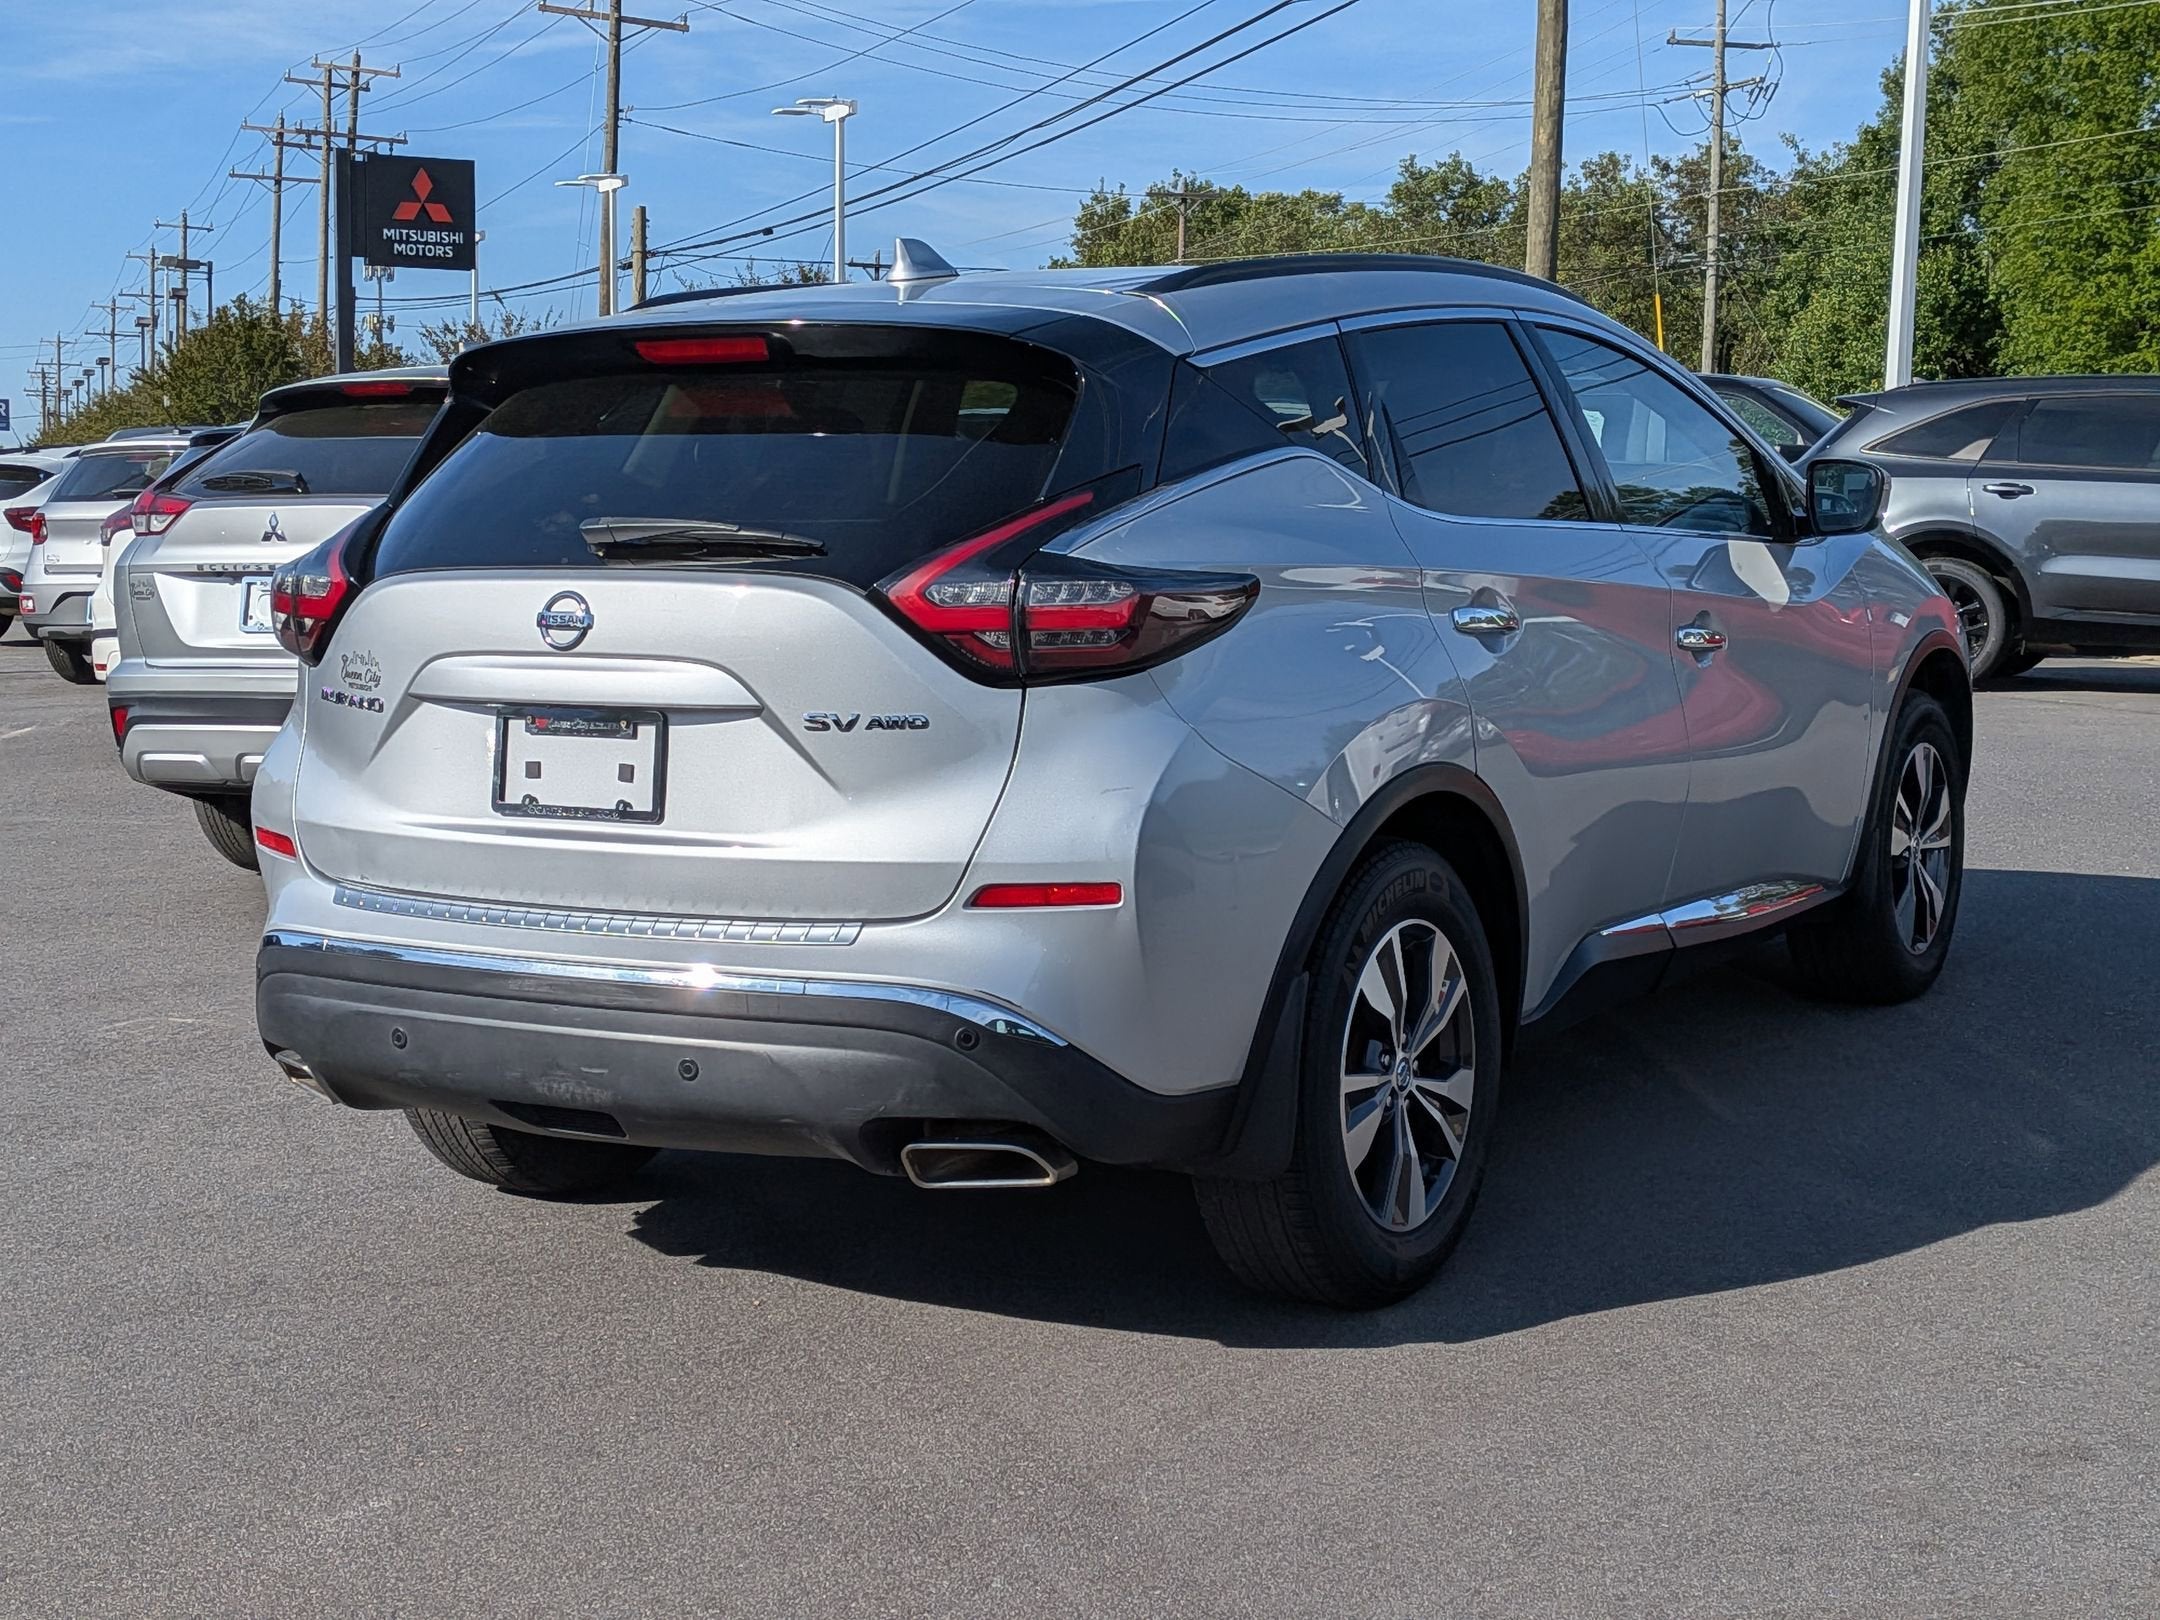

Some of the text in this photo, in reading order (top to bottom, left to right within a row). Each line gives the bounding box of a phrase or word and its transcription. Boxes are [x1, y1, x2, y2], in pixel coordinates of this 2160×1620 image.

[382, 228, 464, 244] MITSUBISHI
[393, 243, 454, 258] MOTORS
[195, 563, 277, 572] ECLIPSE
[540, 613, 586, 626] NISSAN
[341, 658, 363, 683] Queen
[365, 668, 382, 688] City
[802, 711, 931, 733] SV AWD
[1360, 869, 1426, 943] MICHELIN
